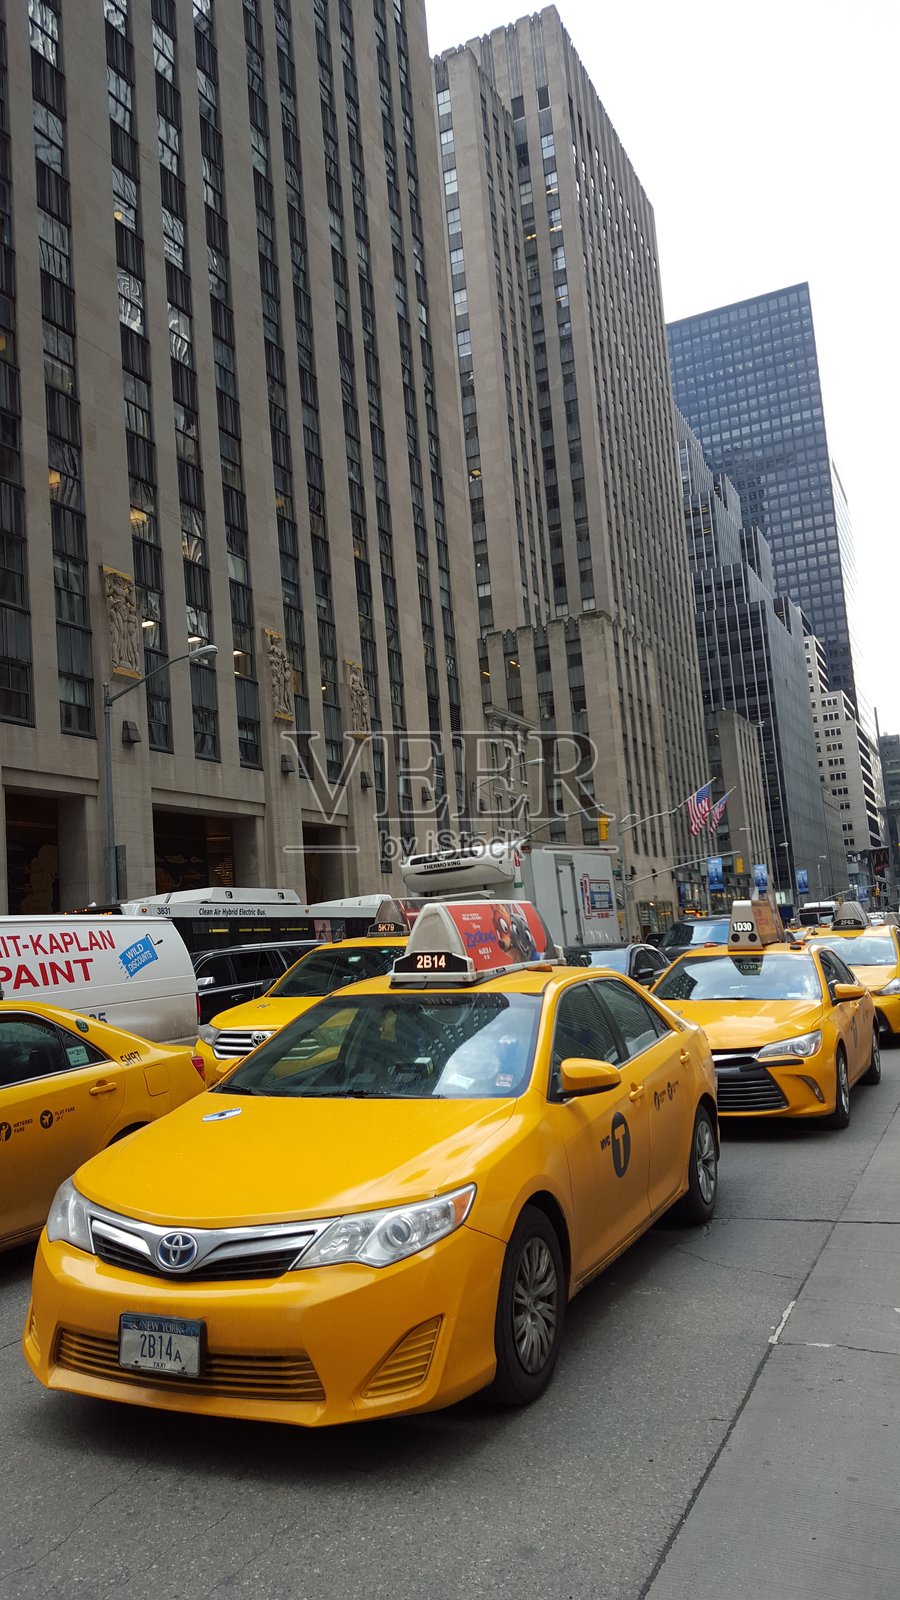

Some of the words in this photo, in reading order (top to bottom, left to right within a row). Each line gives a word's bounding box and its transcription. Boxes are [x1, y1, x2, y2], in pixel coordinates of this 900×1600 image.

[157, 907, 171, 915] 3831
[199, 908, 213, 916] Clean
[222, 908, 238, 917] Hybrid
[239, 908, 256, 916] Electric
[377, 923, 395, 932] 5K79
[733, 922, 752, 931] 1D30
[0, 930, 116, 958] IT-KAPLAN
[125, 943, 144, 960] WILD
[127, 950, 152, 972] DISCOUNTS
[416, 954, 446, 968] 2B14
[0, 958, 94, 990] PAINT
[141, 1320, 159, 1332] NEW
[161, 1321, 184, 1334] YORK
[153, 1361, 167, 1369] TAXI
